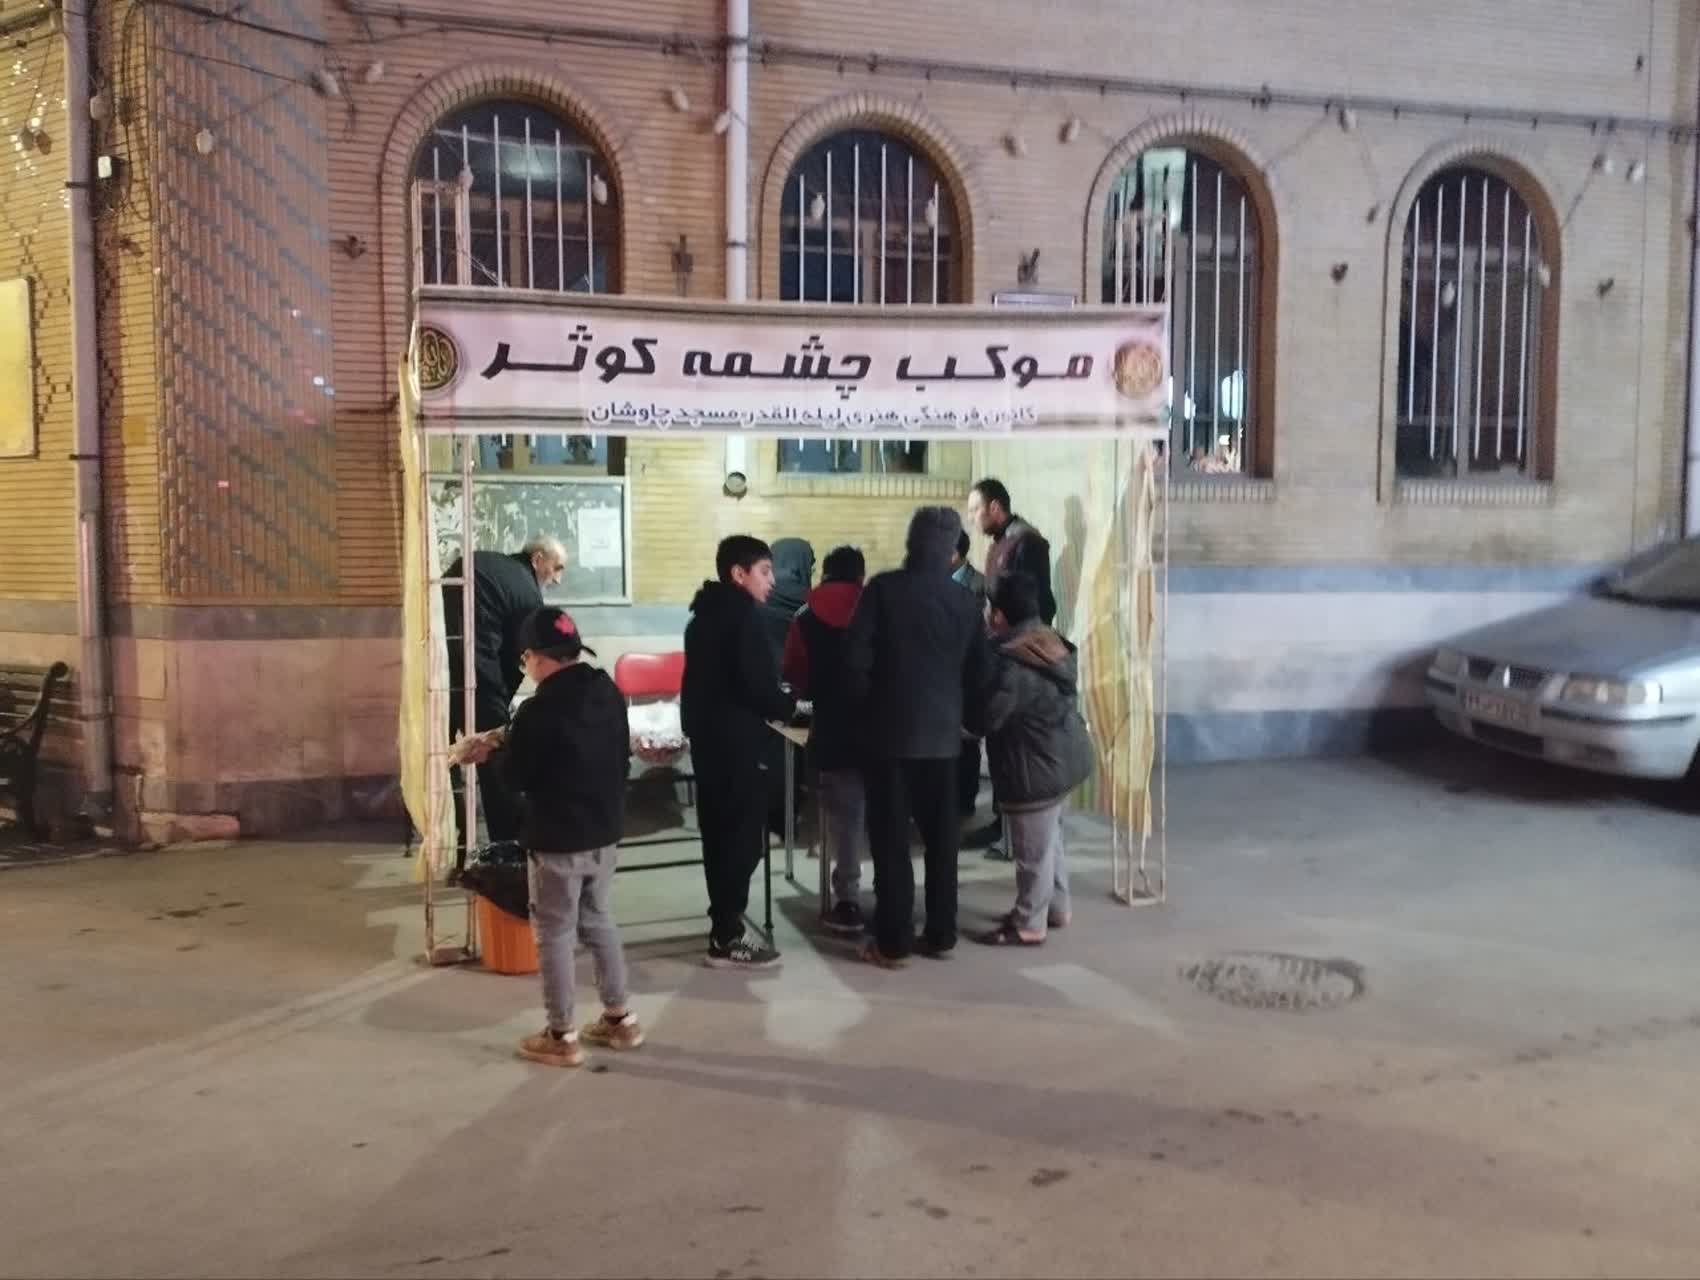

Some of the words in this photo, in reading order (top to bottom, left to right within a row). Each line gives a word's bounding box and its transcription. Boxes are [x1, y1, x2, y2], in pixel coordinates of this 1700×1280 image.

[480, 324, 658, 384] کوثر
[682, 334, 873, 400] چشمه
[896, 343, 1094, 393] موکب
[591, 402, 671, 426] چاوشان
[673, 407, 739, 425] مسجد
[740, 405, 798, 422] القدر
[846, 408, 900, 425] هنری
[903, 405, 980, 425] فرهنگی
